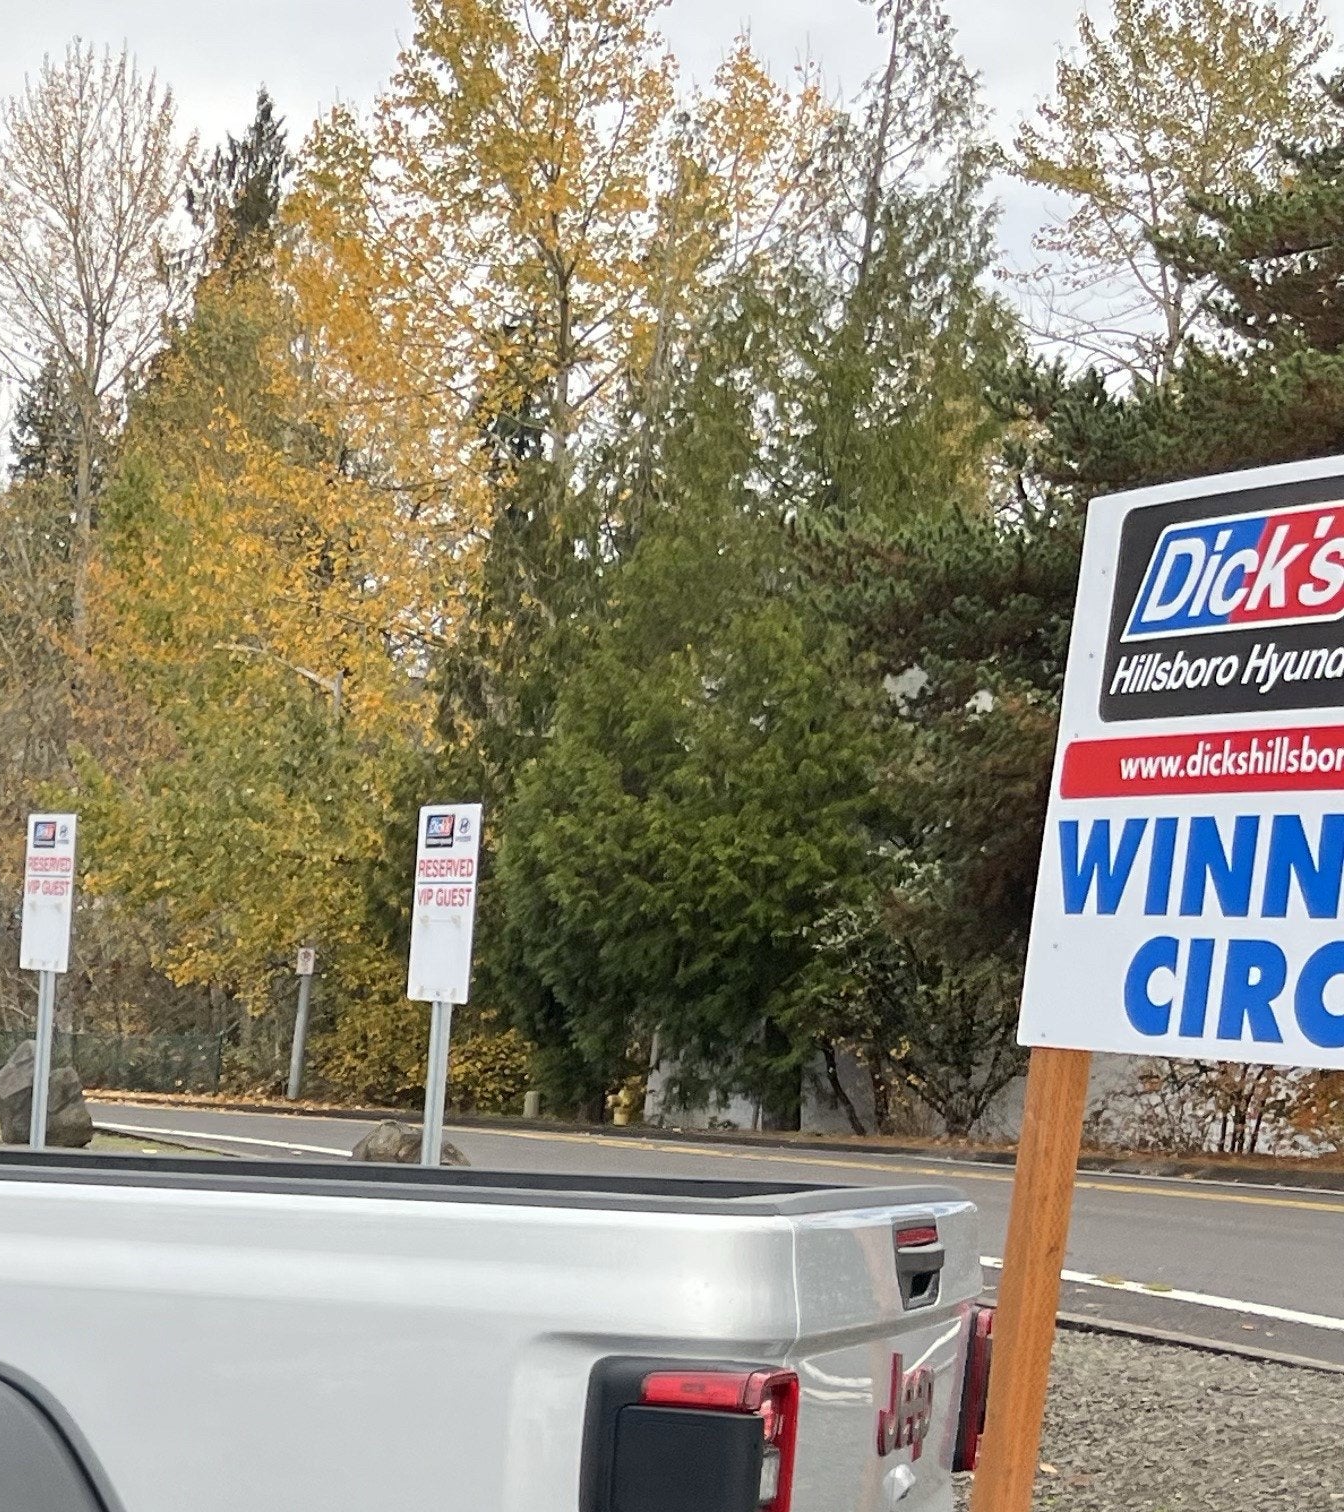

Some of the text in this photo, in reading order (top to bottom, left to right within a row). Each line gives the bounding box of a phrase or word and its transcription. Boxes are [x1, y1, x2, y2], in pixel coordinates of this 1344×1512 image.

[1141, 515, 1344, 623] Dick's
[1109, 650, 1239, 696] Hillsboro
[417, 888, 472, 907] VIP GUEST
[418, 858, 474, 878] RESERVED
[1058, 814, 1344, 919] WINN
[1123, 935, 1344, 1049] CIRC
[877, 1352, 935, 1462] Jeep
